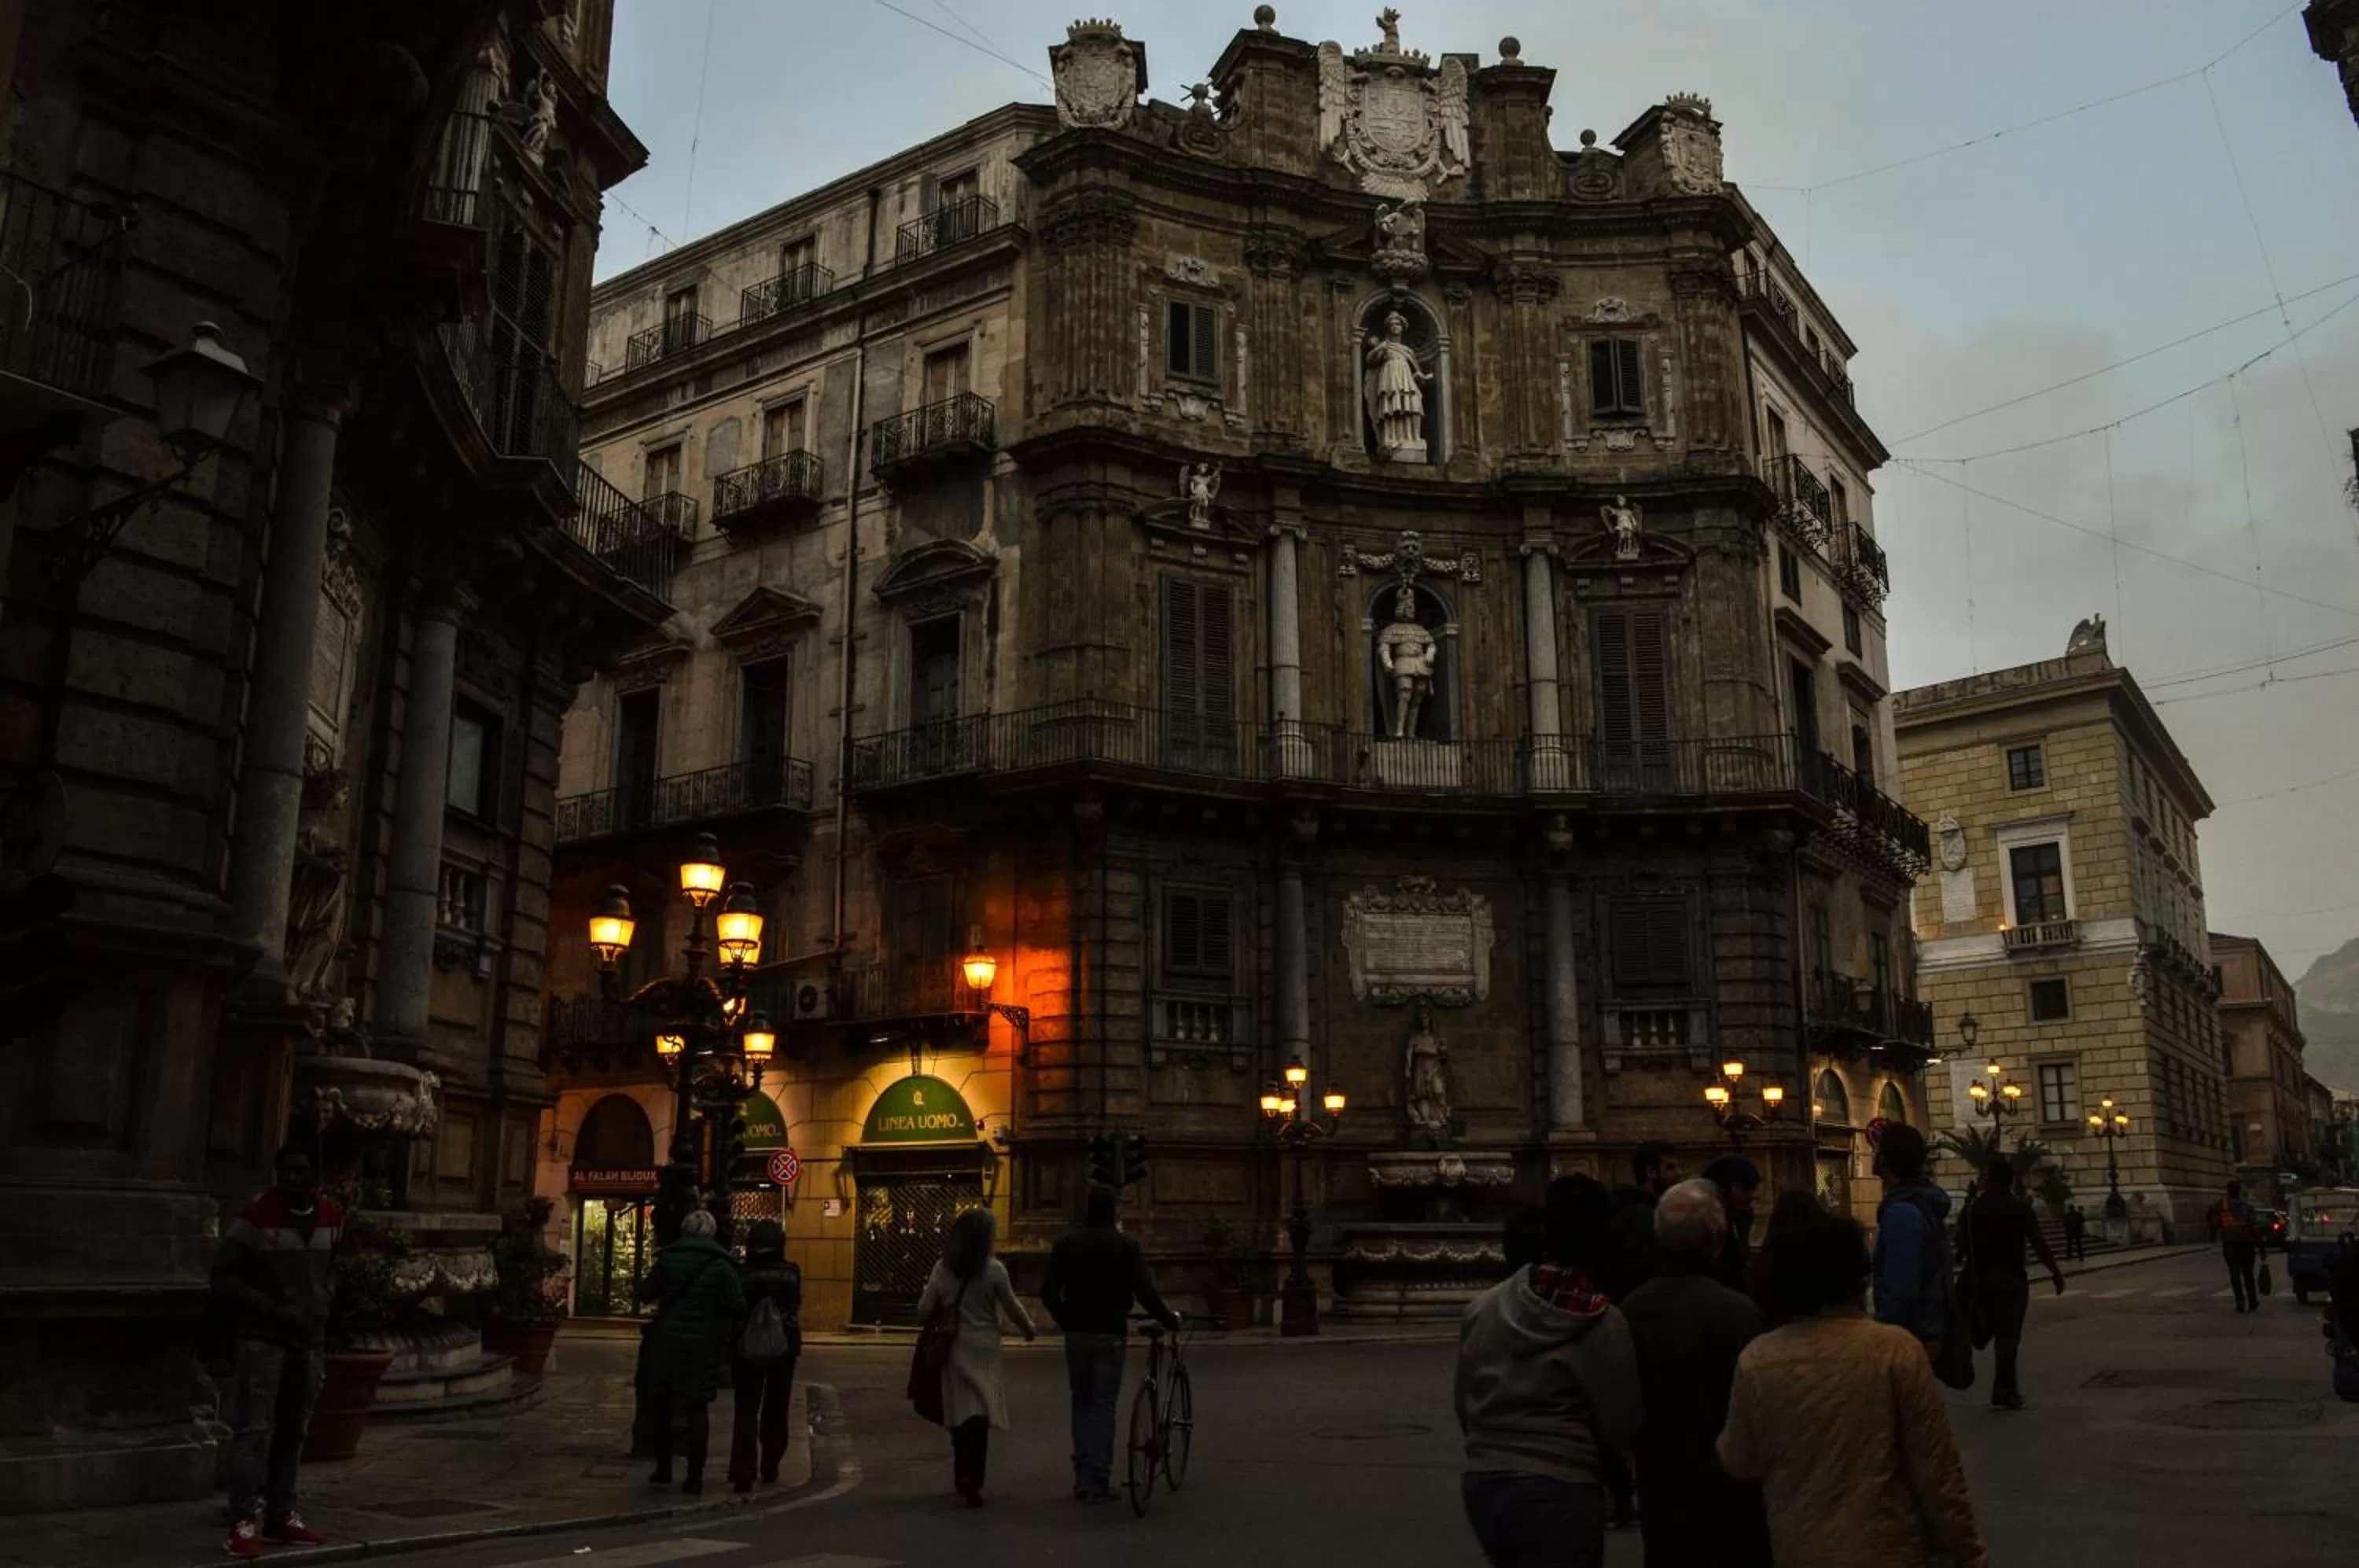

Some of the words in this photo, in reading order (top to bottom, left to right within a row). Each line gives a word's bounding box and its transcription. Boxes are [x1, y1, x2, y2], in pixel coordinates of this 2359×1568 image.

[878, 1115, 915, 1132] LINEA
[918, 1113, 957, 1130] UOMO
[620, 1170, 657, 1181] BIJOUX
